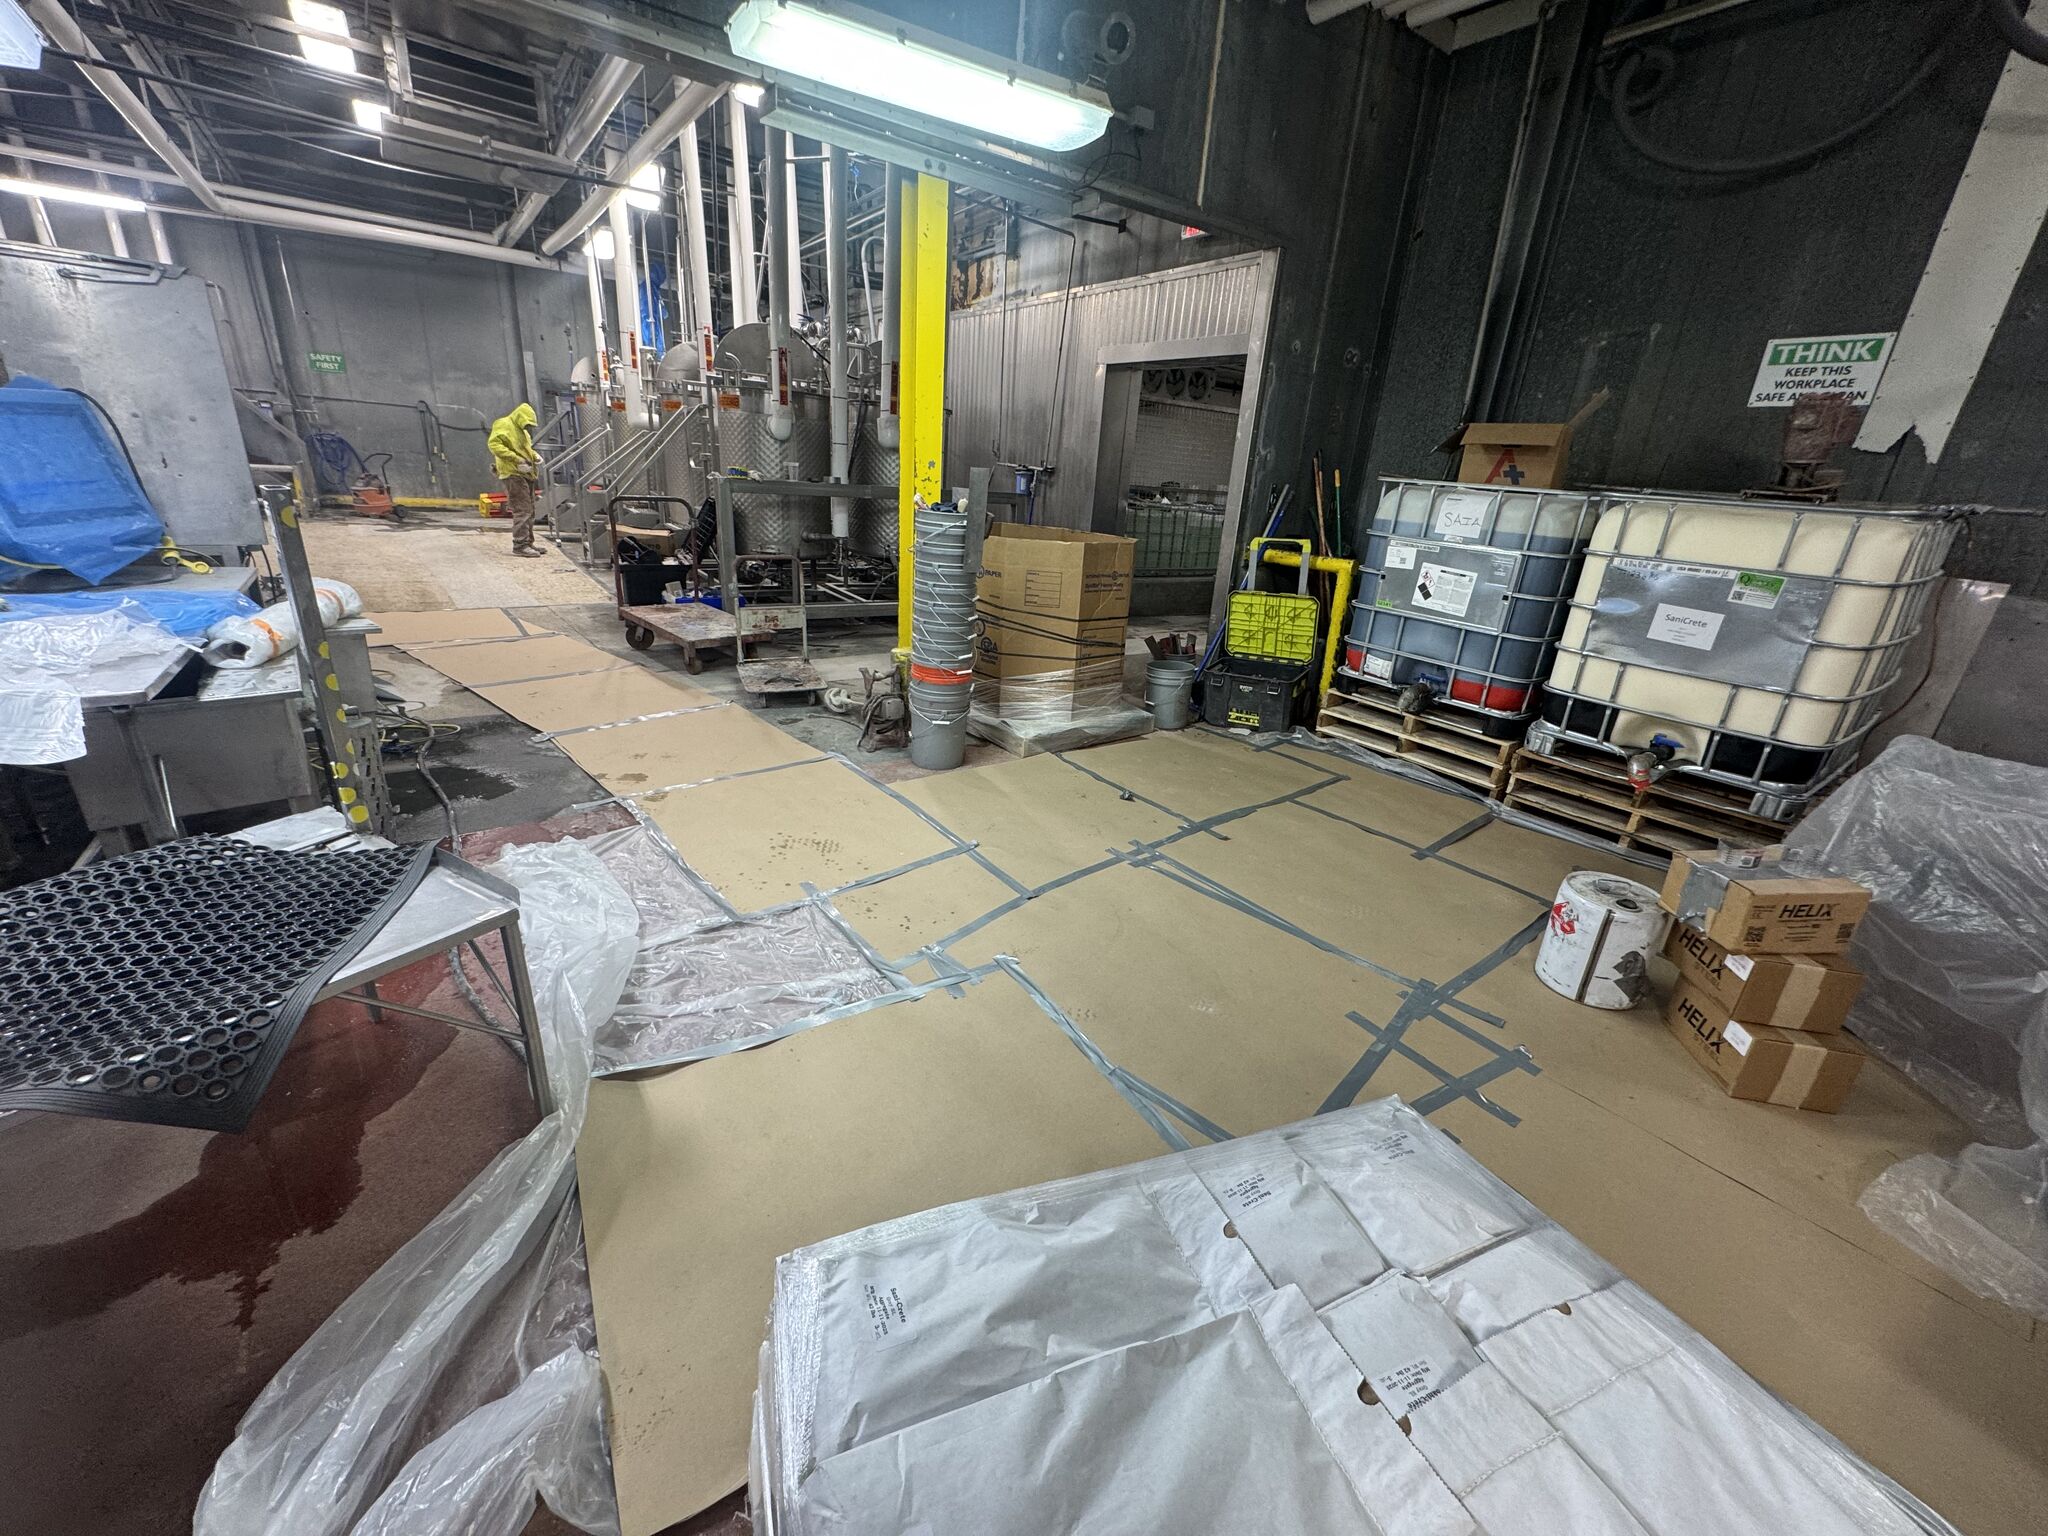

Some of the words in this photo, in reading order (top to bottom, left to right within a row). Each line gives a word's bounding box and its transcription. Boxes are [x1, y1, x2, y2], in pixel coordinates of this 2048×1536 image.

[310, 353, 342, 362] SAFETY
[1775, 340, 1877, 363] THINK
[316, 361, 339, 370] FIRST
[1784, 367, 1818, 378] KEEP
[1820, 365, 1852, 376] THIS
[1774, 378, 1856, 390] WORKPLACE
[1755, 393, 1786, 402] SAFE
[1665, 613, 1708, 628] SaniCrete
[1778, 903, 1841, 918] HELIX
[1679, 927, 1728, 980] HELIX
[1677, 997, 1727, 1054] HELIX
[890, 1287, 906, 1323] Sani-Crete
[1401, 1377, 1425, 1391] Aggregate
